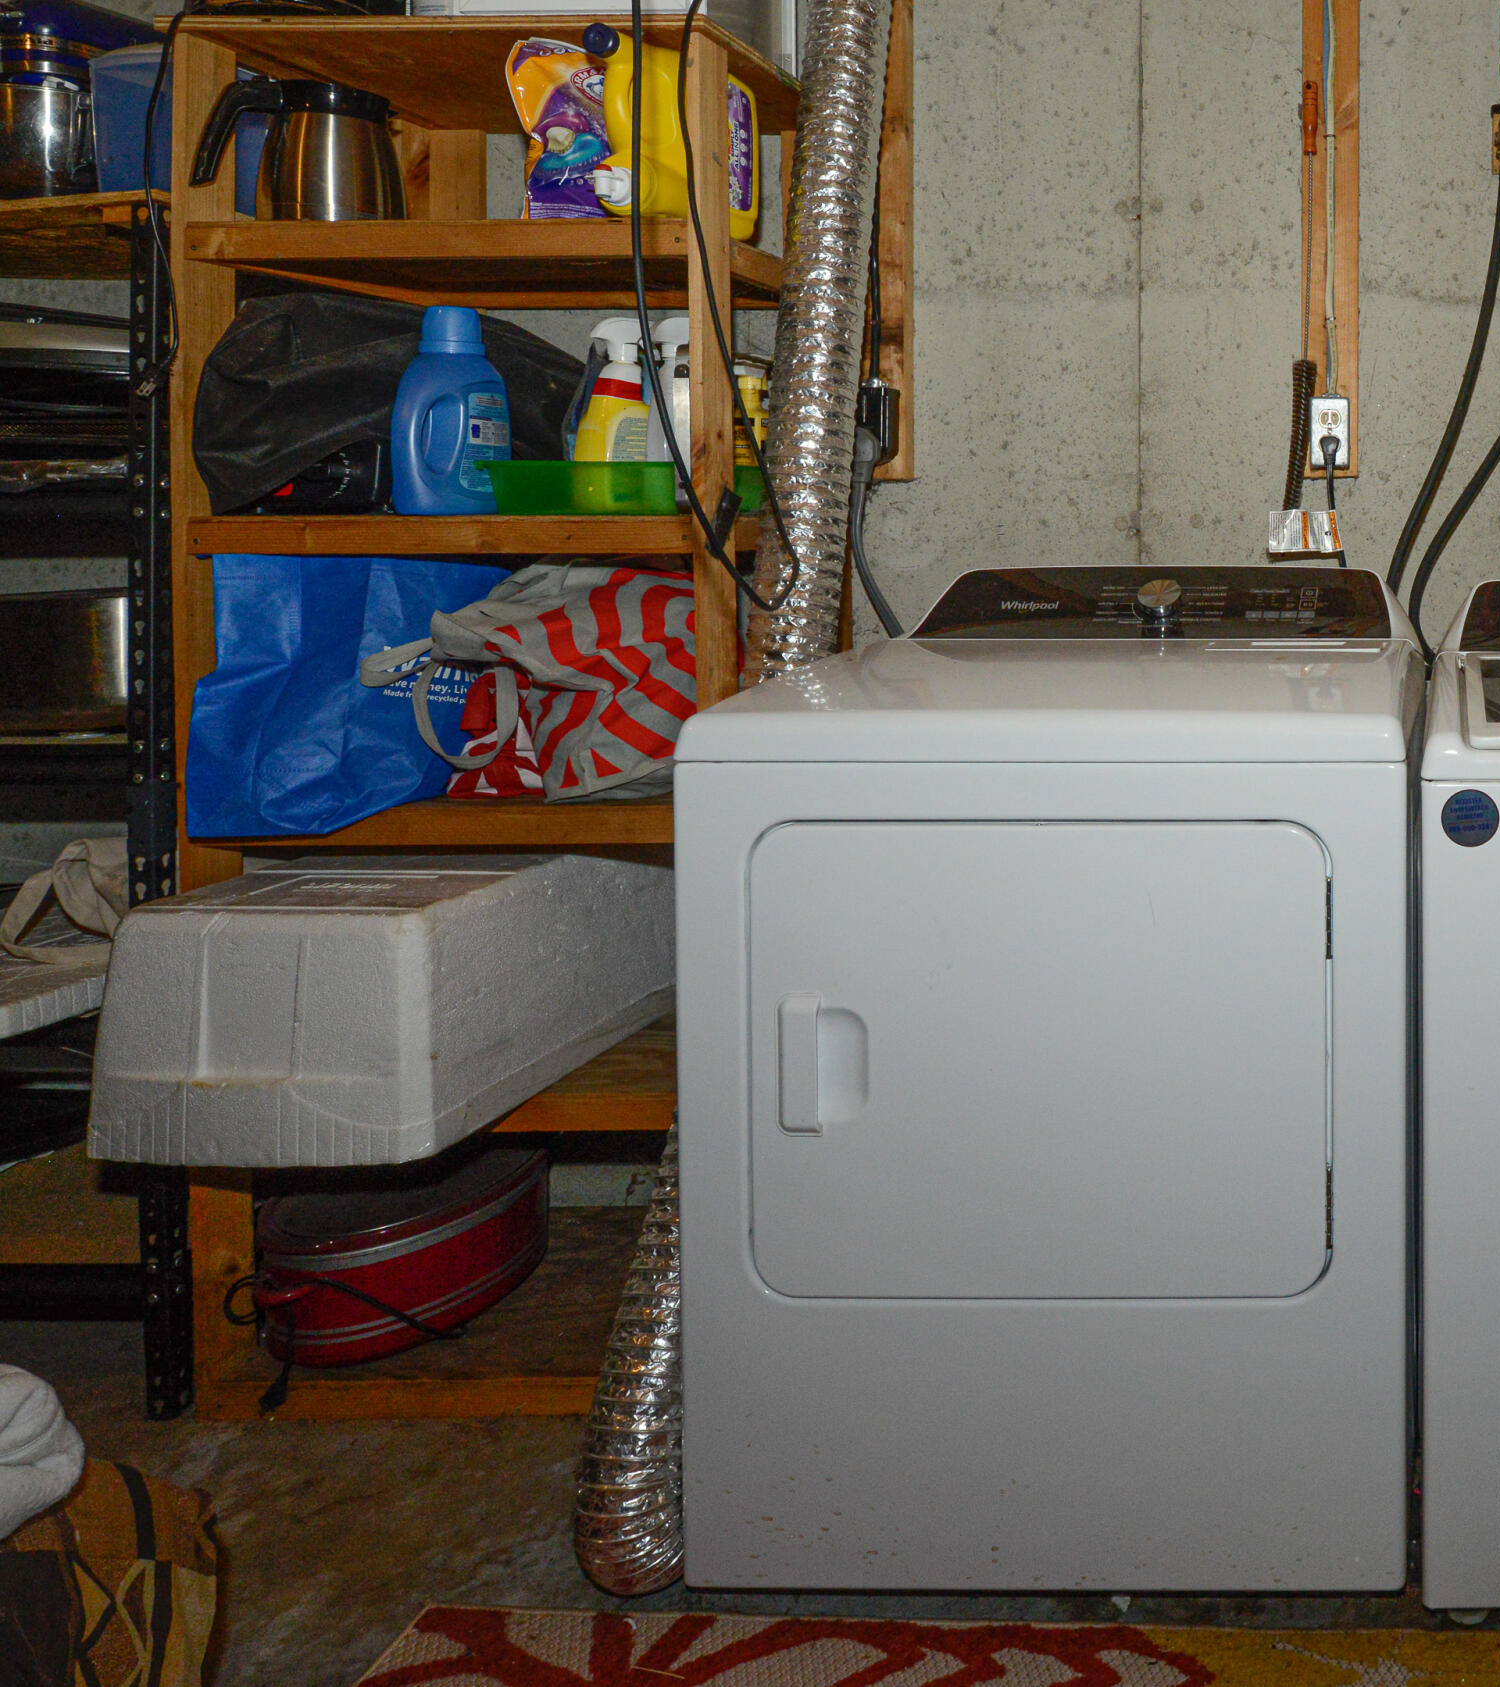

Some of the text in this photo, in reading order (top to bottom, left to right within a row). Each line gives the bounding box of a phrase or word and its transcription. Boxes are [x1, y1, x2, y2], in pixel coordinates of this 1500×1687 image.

[575, 68, 589, 87] ARM
[1001, 600, 1059, 612] Whirlpool
[383, 689, 404, 697] Made
[427, 695, 458, 704] recycled
